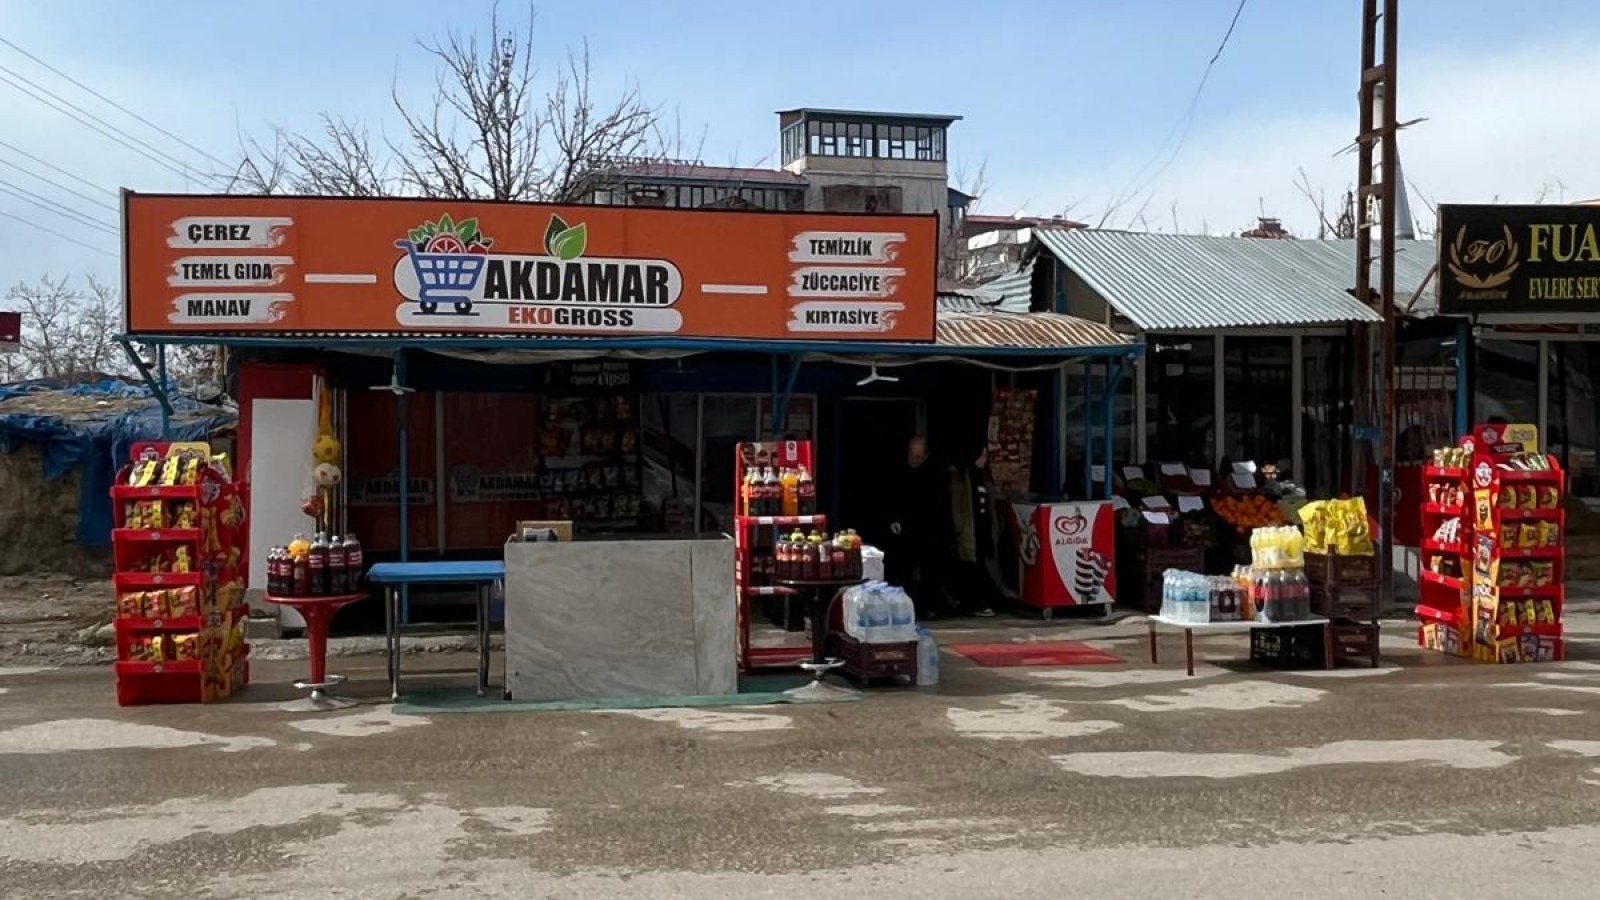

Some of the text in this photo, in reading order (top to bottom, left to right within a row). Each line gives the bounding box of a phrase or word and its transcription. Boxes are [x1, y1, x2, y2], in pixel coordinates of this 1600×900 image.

[188, 224, 251, 244] ÇEREZ
[809, 237, 873, 256] TEMİZLİK
[181, 263, 273, 280] TEMEL GIDA
[484, 260, 669, 304] AKDAMAR
[802, 272, 881, 292] ZÜCCACİYE
[1529, 277, 1574, 299] EVLERE
[1576, 277, 1600, 299] SER
[188, 300, 251, 316] MANAV
[508, 307, 634, 326] EKOGROSS
[806, 308, 879, 325] KIRTASİYE
[1055, 537, 1088, 546] ALGIDA
